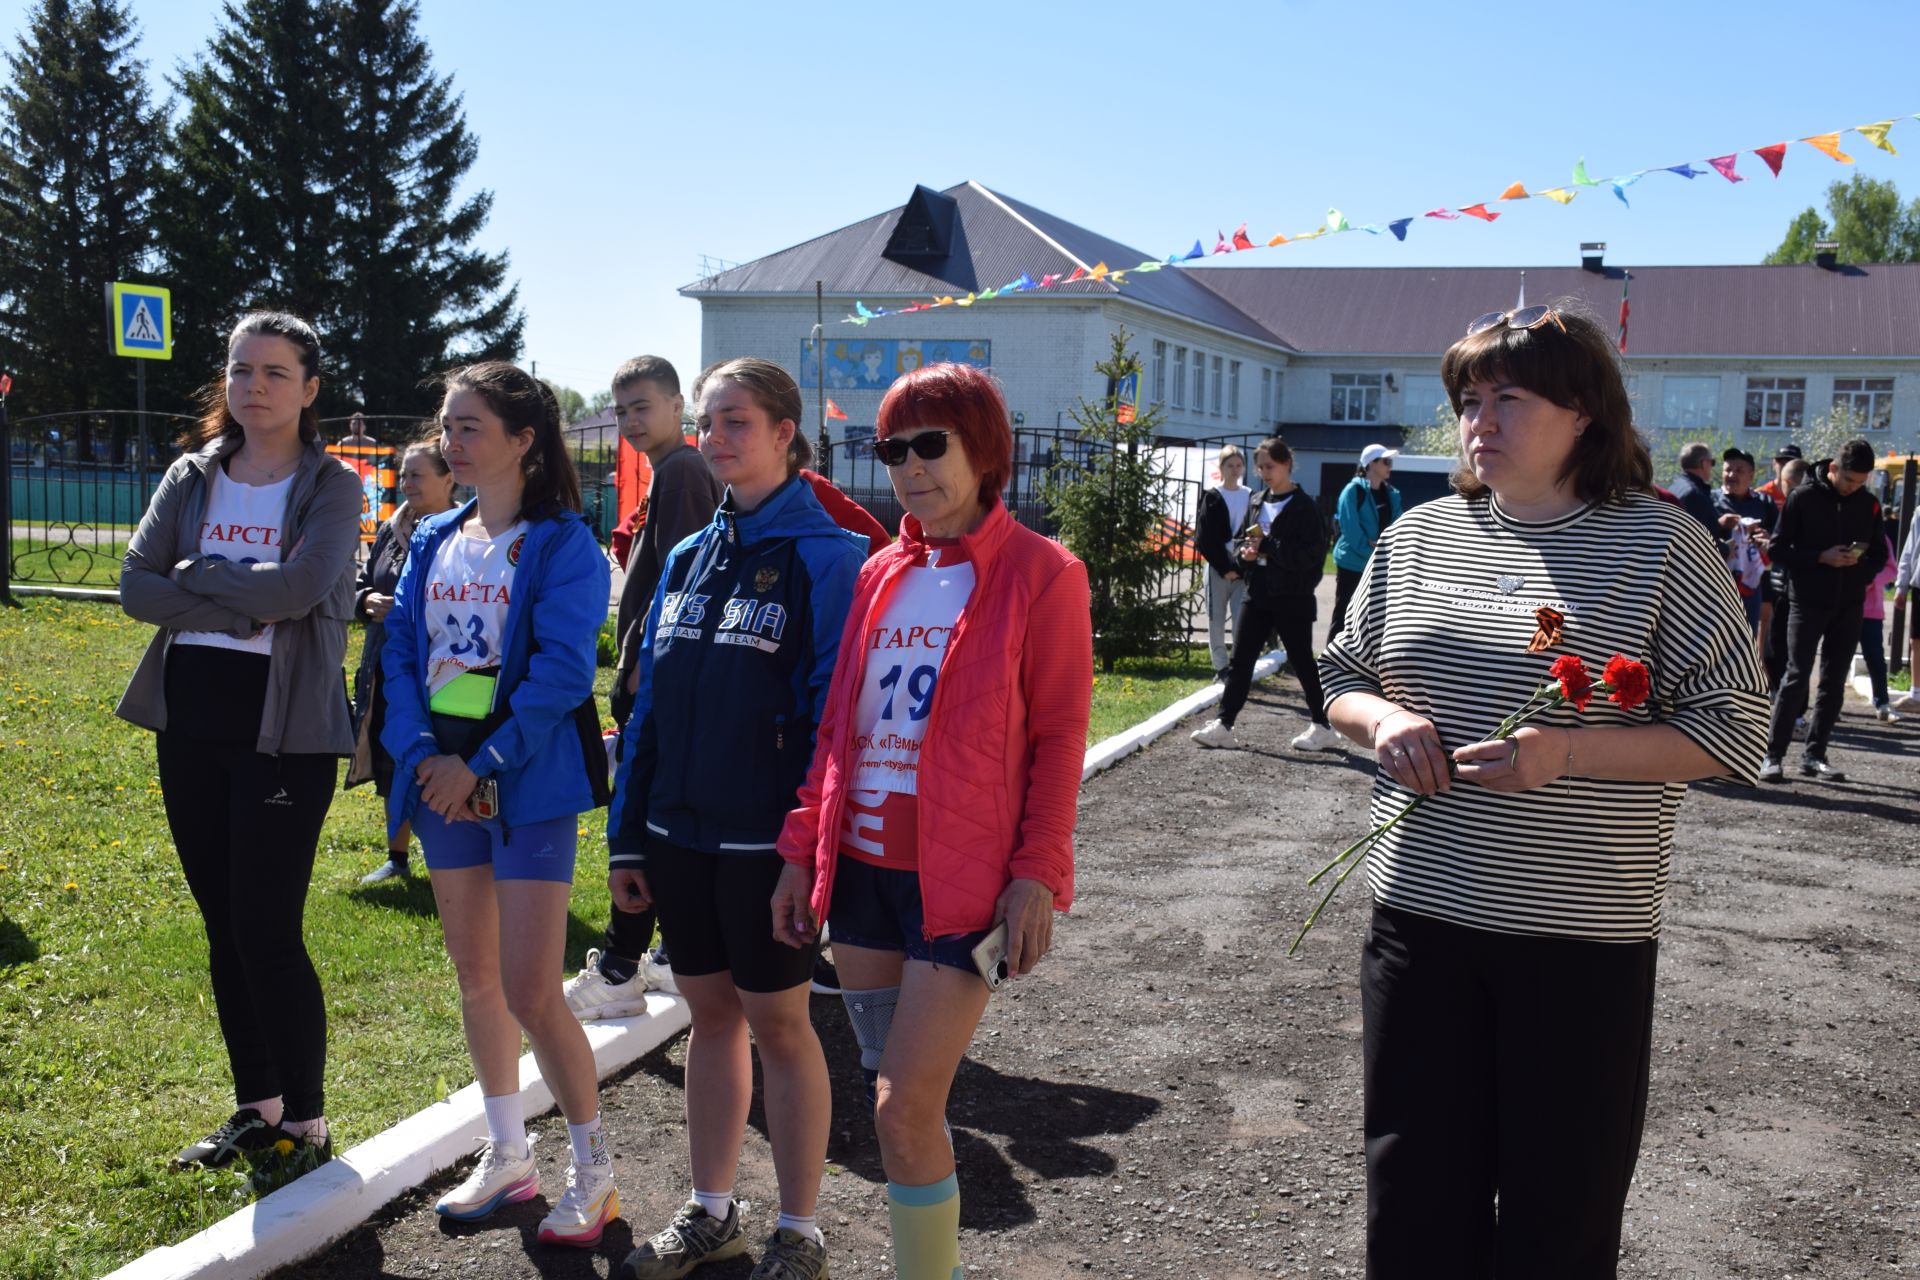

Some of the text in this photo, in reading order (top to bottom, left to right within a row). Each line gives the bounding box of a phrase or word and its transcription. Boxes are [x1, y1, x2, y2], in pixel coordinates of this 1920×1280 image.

[199, 522, 284, 547] ТАРСТ
[719, 598, 787, 640] SIA
[727, 633, 761, 646] TEAM
[880, 664, 938, 721] 19
